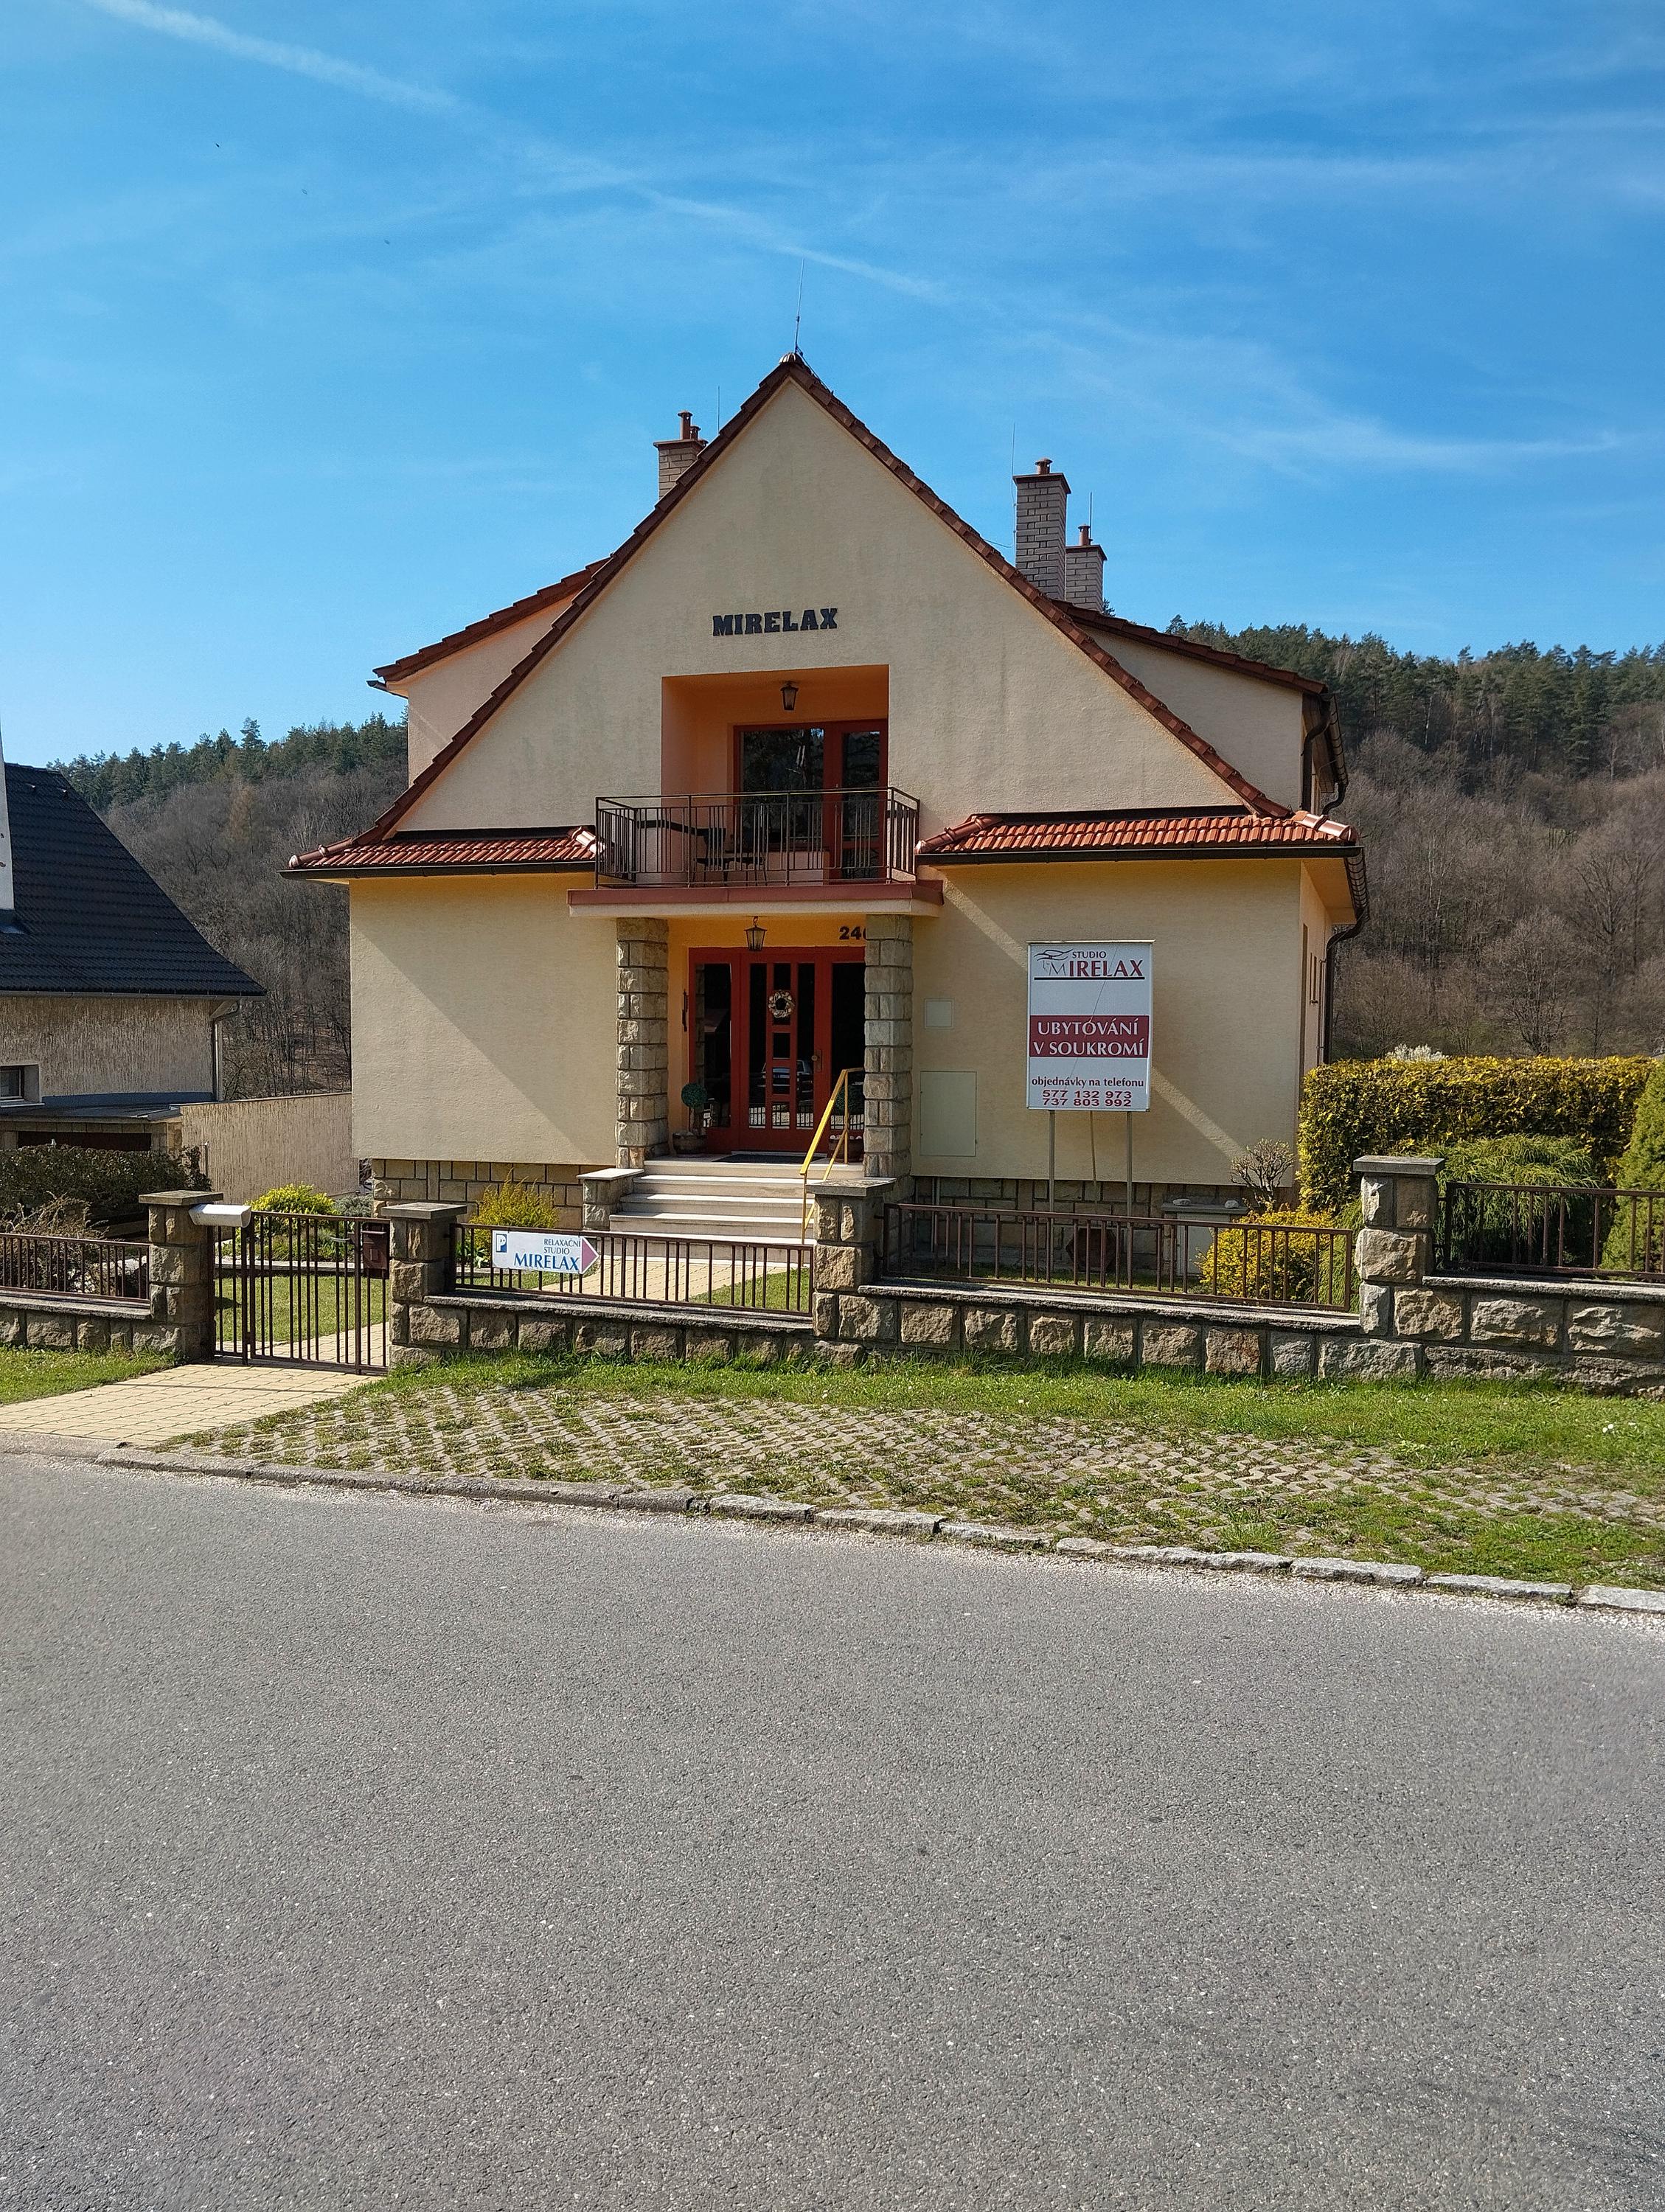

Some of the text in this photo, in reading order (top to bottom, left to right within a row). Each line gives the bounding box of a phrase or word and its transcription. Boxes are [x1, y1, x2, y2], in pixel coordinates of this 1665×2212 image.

[712, 608, 838, 636] MIRELAX
[1049, 959, 1143, 977] MIRELAX
[1033, 1038, 1144, 1056] V SOUKROMÍ
[1032, 1077, 1087, 1088] objednávky
[1103, 1077, 1144, 1087] telefonu
[1042, 1090, 1068, 1098] 577
[1042, 1098, 1131, 1107] 737 803 992
[543, 1247, 570, 1255] STUDIO
[514, 1253, 579, 1271] MIRELAX
